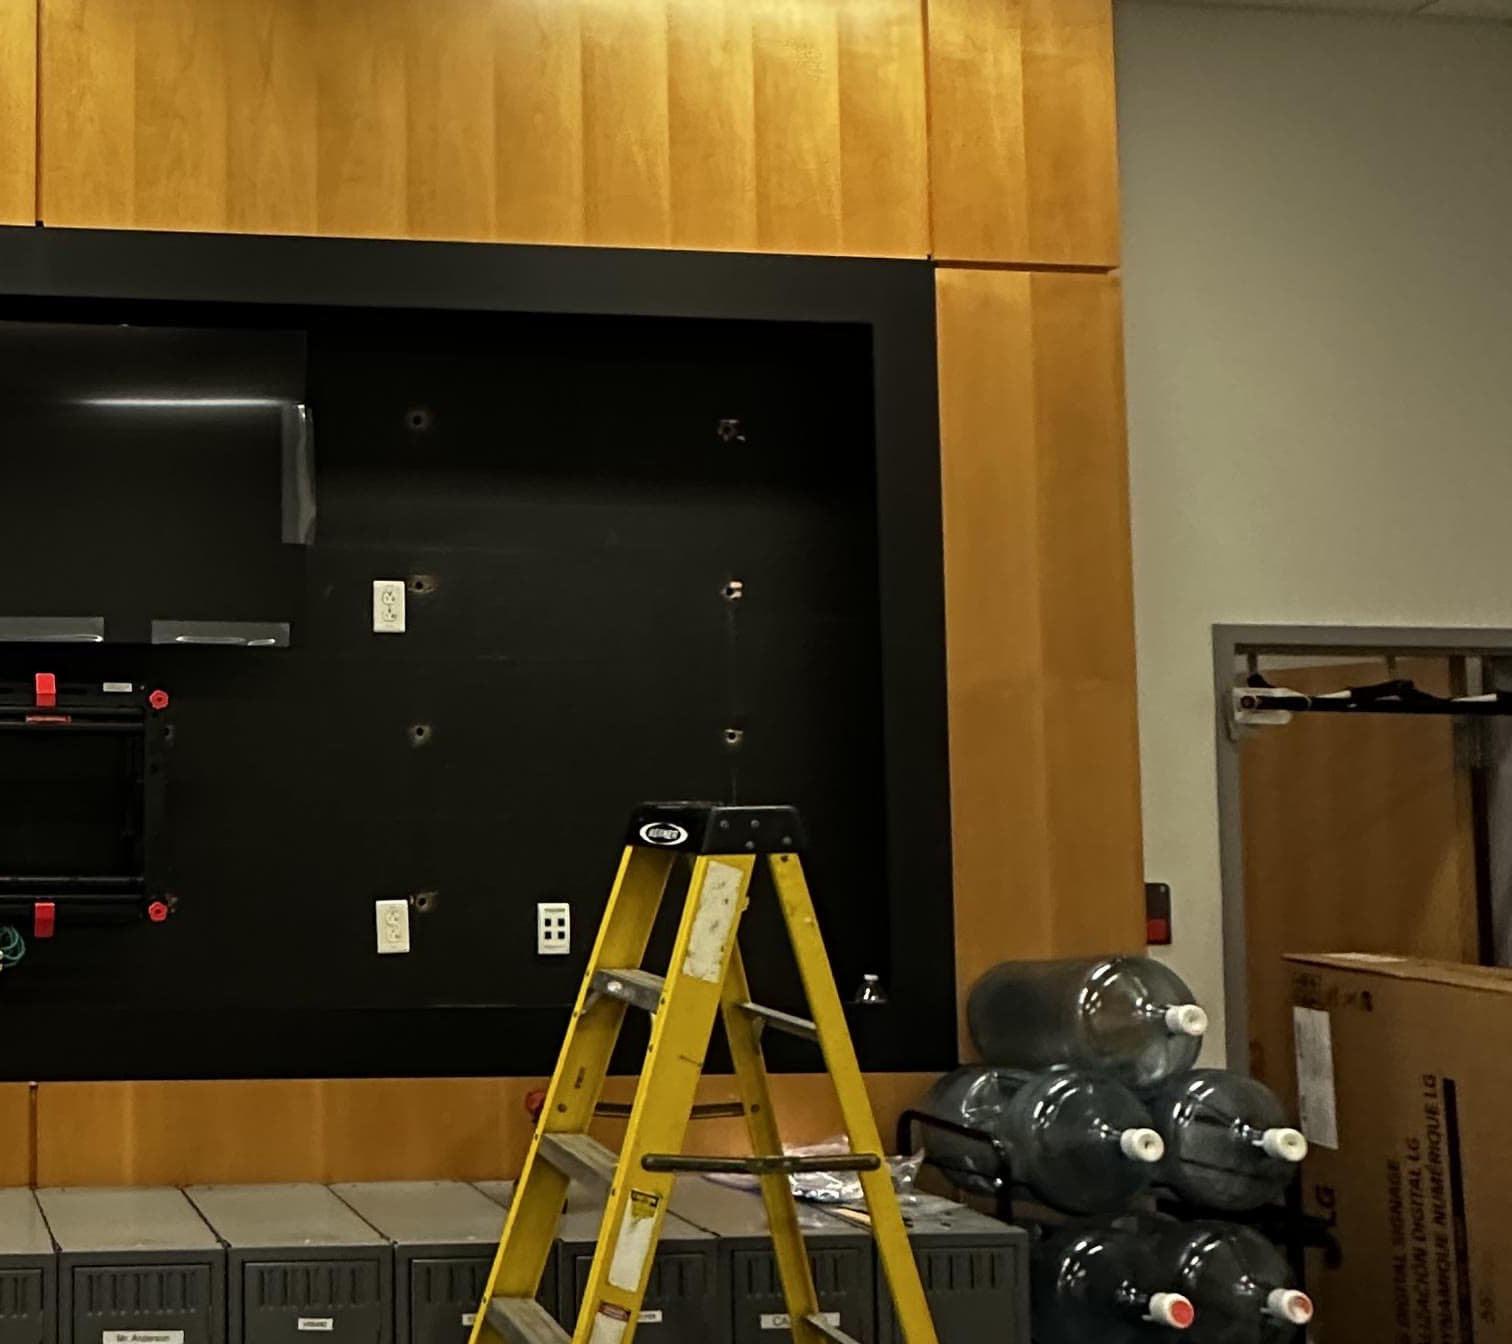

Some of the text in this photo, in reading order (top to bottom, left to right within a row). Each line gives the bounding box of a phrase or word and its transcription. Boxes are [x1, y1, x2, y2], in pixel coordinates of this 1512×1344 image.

[1422, 1073, 1438, 1099] LG
[1406, 1137, 1421, 1162] LG
[1424, 1103, 1448, 1228] NUMÉRIQUE
[1315, 1183, 1337, 1228] LG
[1387, 1158, 1405, 1246] SIGNAGE
[1407, 1167, 1427, 1242] DIGITAL
